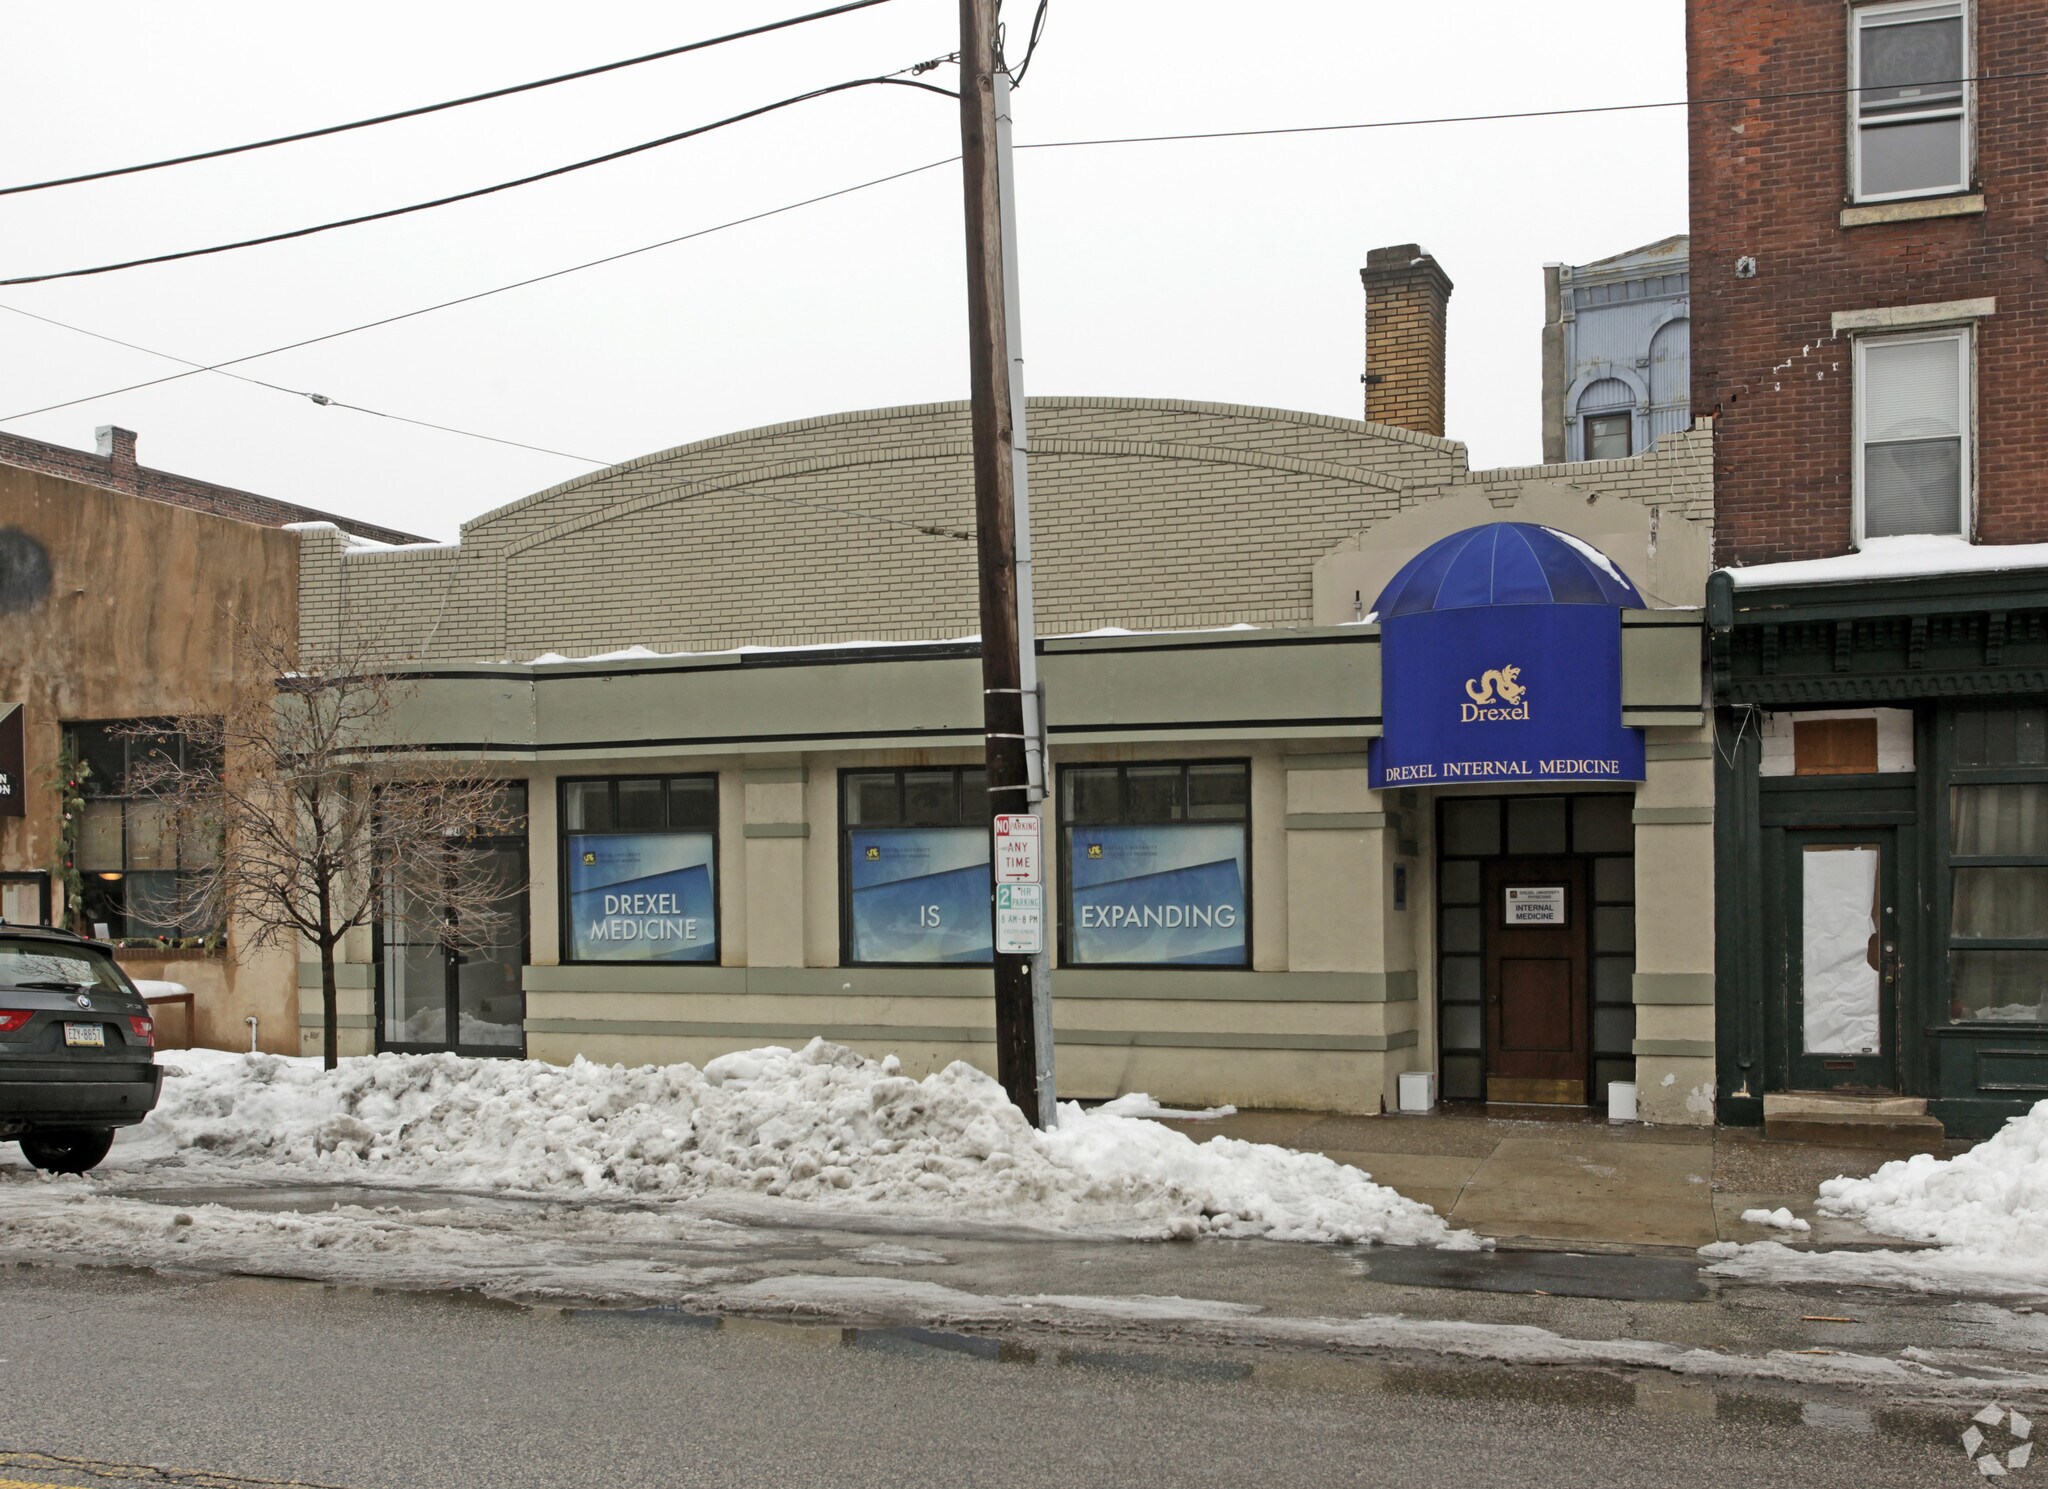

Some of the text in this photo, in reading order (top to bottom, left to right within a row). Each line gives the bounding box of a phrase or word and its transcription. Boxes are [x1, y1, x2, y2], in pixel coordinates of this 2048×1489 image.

[1460, 702, 1530, 722] Drexel
[1385, 759, 1620, 782] DREXEL INTERNAL MEDICINE
[996, 819, 1037, 834] NO PARKING
[1007, 842, 1028, 853] ANY
[1006, 857, 1030, 868] TIME
[605, 894, 681, 915] DREXEL
[1000, 887, 1032, 906] 2 HR
[1012, 898, 1039, 907] PARKING
[920, 905, 941, 928] IS
[1029, 915, 1038, 924] PM
[1081, 904, 1237, 929] EXPANDING
[590, 919, 697, 941] MEDICINE
[126, 1002, 142, 1010] X3
